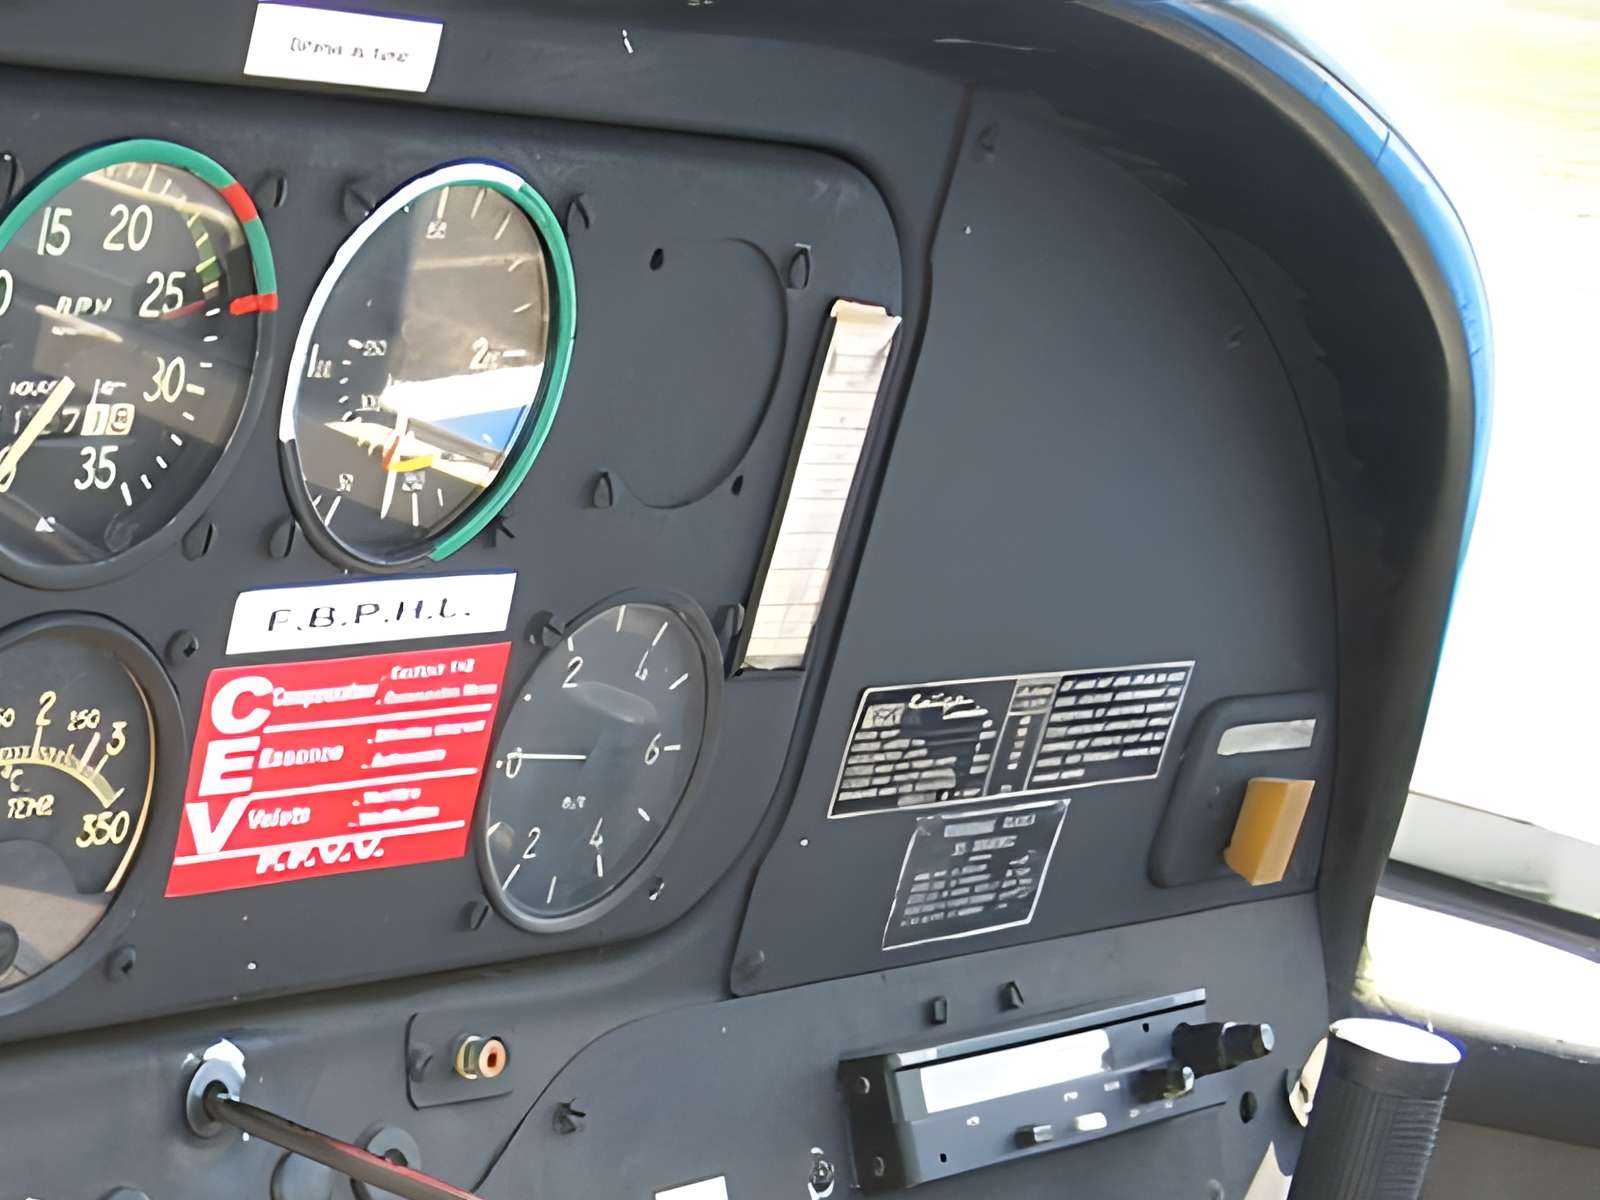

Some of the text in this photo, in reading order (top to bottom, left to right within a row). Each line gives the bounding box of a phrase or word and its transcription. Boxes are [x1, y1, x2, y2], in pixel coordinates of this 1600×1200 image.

[37, 207, 73, 256] 15
[103, 204, 153, 252] 20
[139, 271, 186, 318] 25
[143, 356, 186, 403] 30
[73, 445, 120, 490] 35
[563, 656, 584, 688] 2
[36, 690, 57, 726] 2
[106, 720, 128, 756] 3
[644, 732, 662, 765] 6
[523, 827, 541, 859] 2
